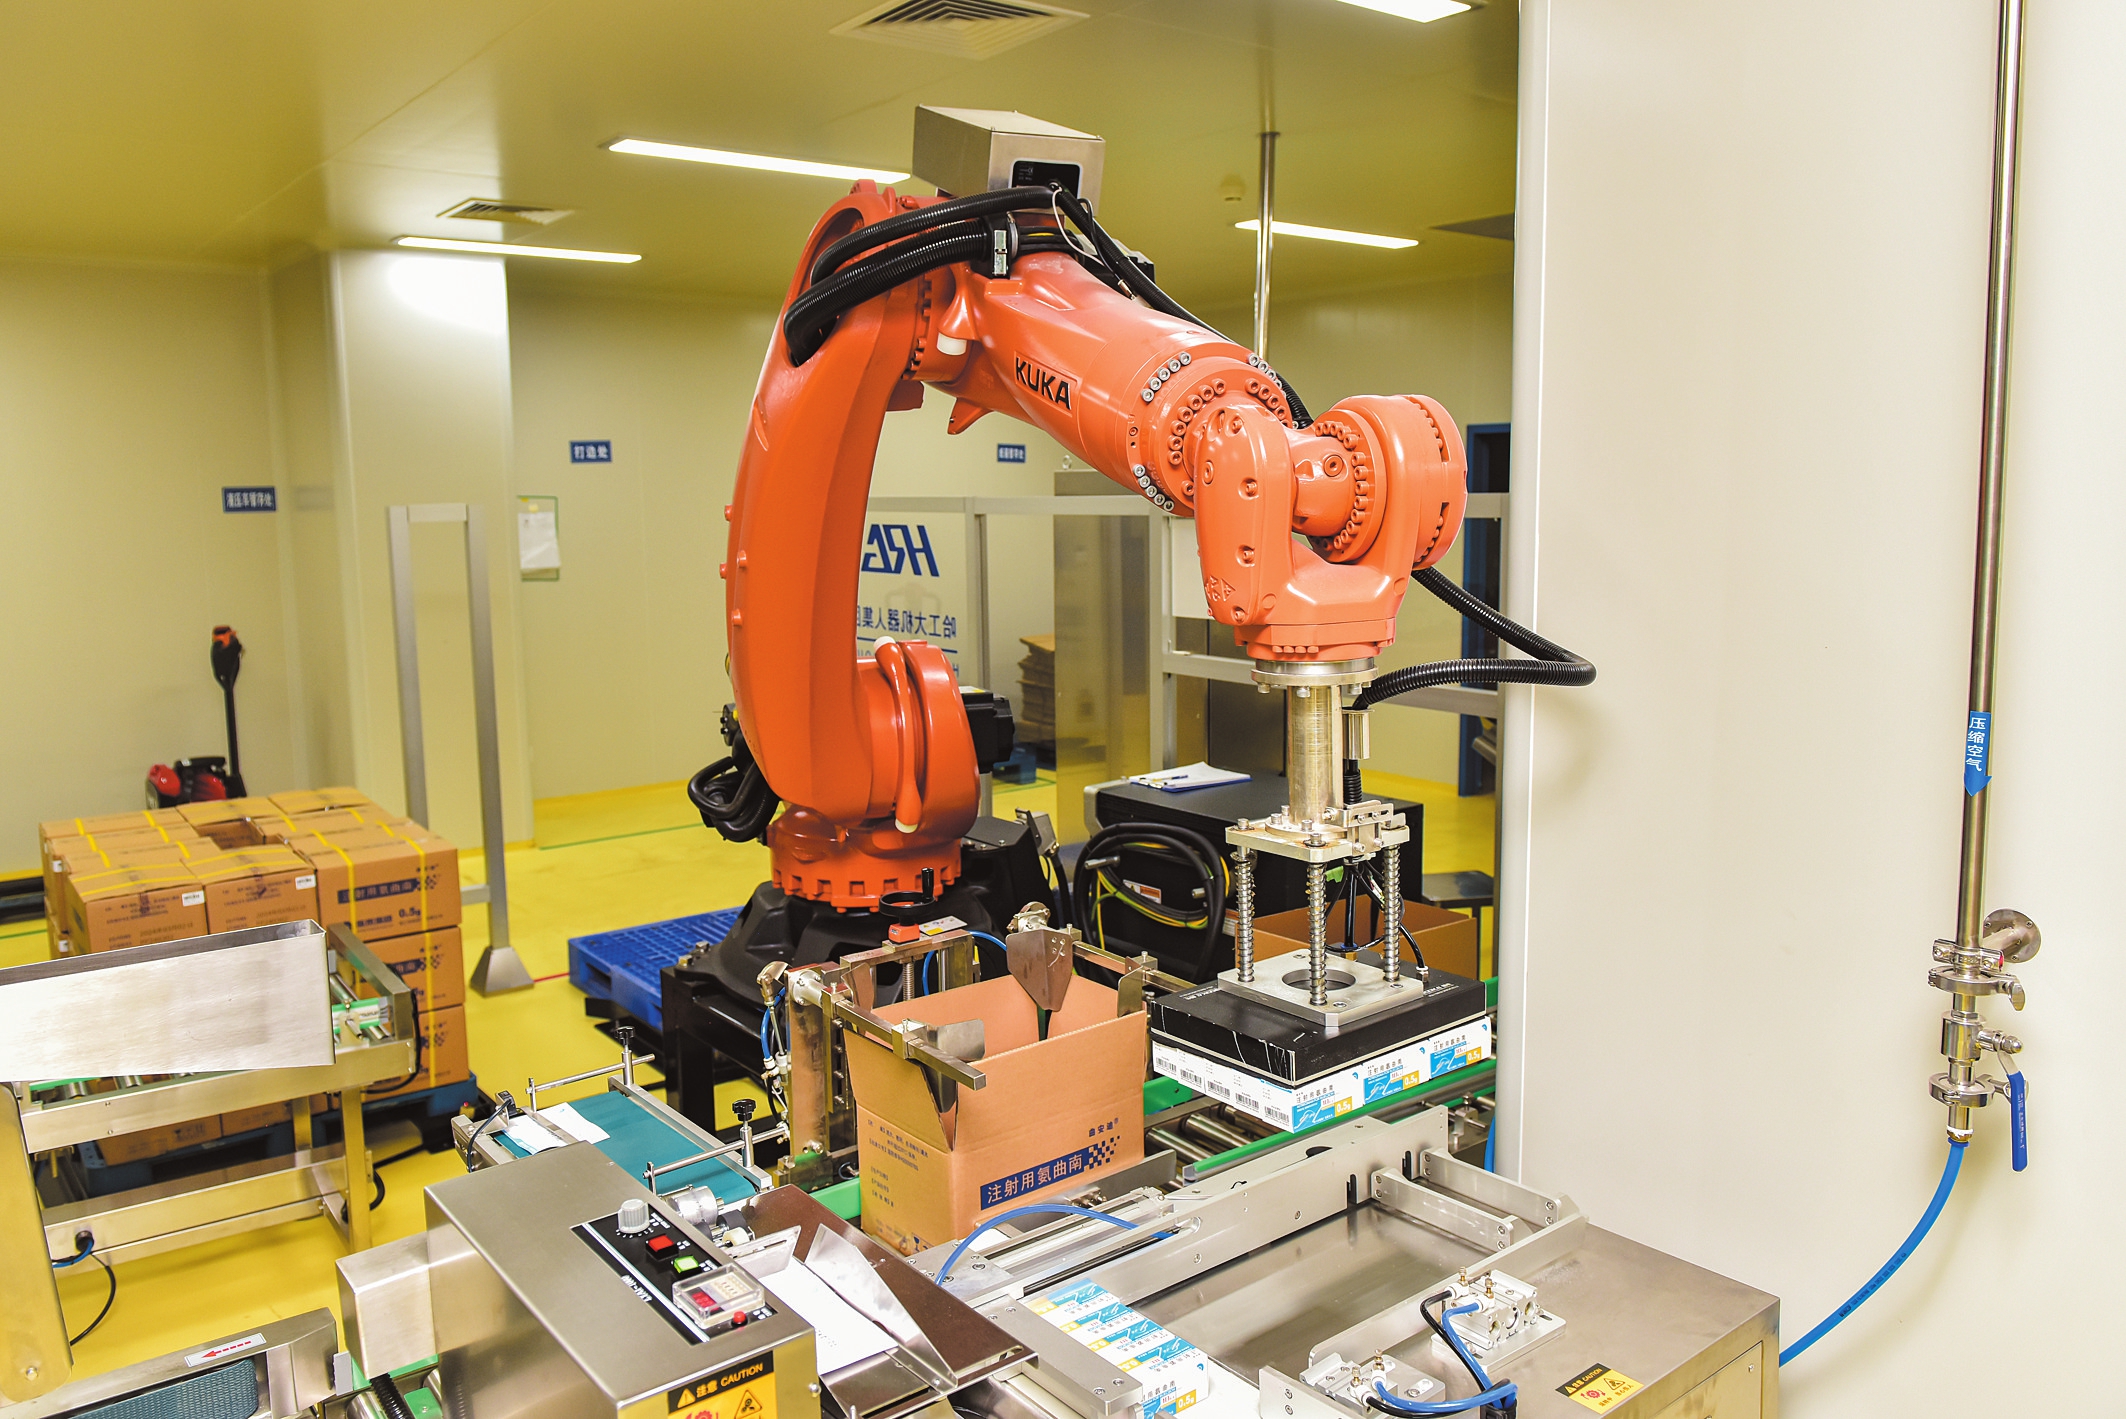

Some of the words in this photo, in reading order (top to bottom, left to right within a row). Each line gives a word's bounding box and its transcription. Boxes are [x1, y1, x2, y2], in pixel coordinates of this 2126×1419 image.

[1015, 356, 1071, 410] KUKA
[1965, 716, 1987, 772] 压缩空气
[987, 1153, 1083, 1204] 注射用氨曲南
[696, 1380, 719, 1398] 注意
[720, 1363, 764, 1387] CAUTION
[1582, 1367, 1603, 1382] CAUTION
[1178, 1394, 1195, 1409] 0.5g
